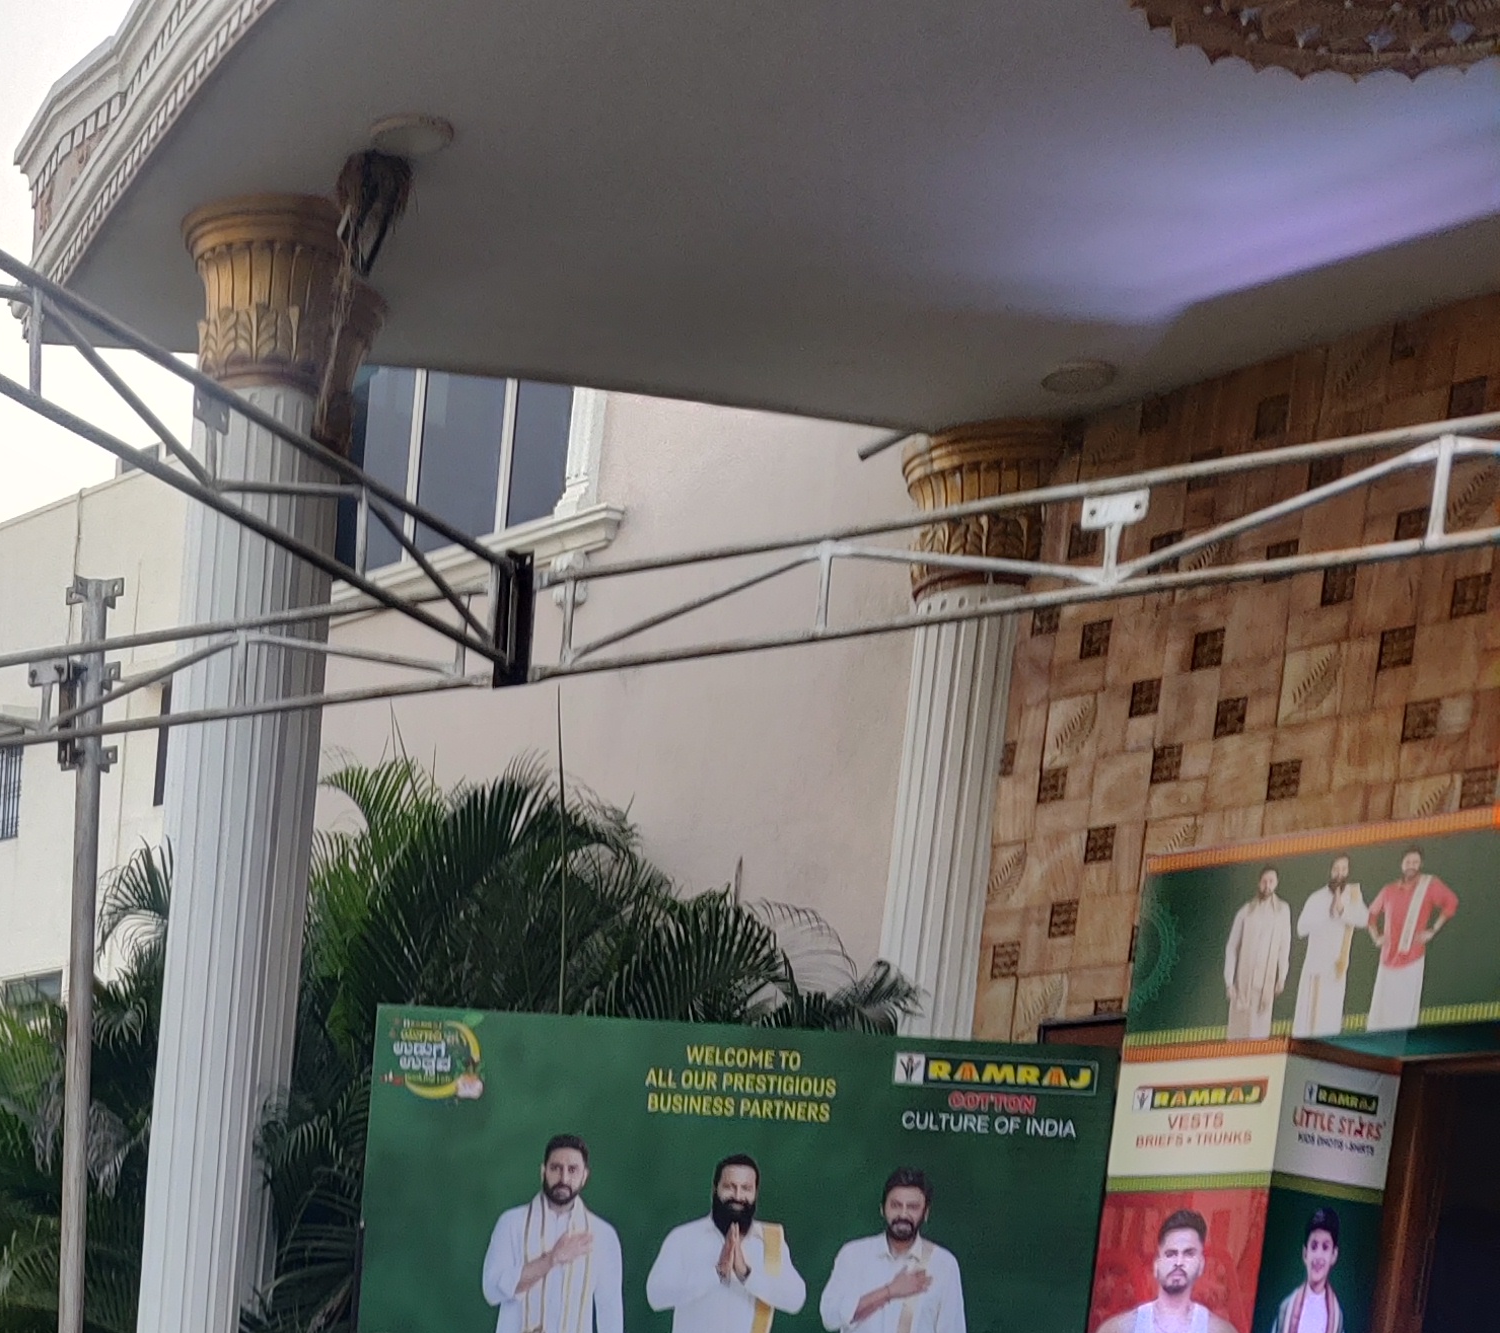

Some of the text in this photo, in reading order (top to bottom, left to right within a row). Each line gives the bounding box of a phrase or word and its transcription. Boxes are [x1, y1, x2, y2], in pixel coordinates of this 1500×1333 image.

[686, 1044, 801, 1071] WELCOME TO
[645, 1067, 837, 1098] ALL OUR PRESTIGIOUS
[928, 1059, 1093, 1090] RAMRAJ
[647, 1092, 831, 1123] BUSINESS PARTNERS
[948, 1090, 1038, 1115] COTTON
[1153, 1086, 1261, 1108] RAMRAJ
[902, 1110, 1077, 1138] CULTURE OF INDIA
[1167, 1112, 1225, 1131] VESTS
[1135, 1130, 1252, 1149] BRIEFS TRUNKS
